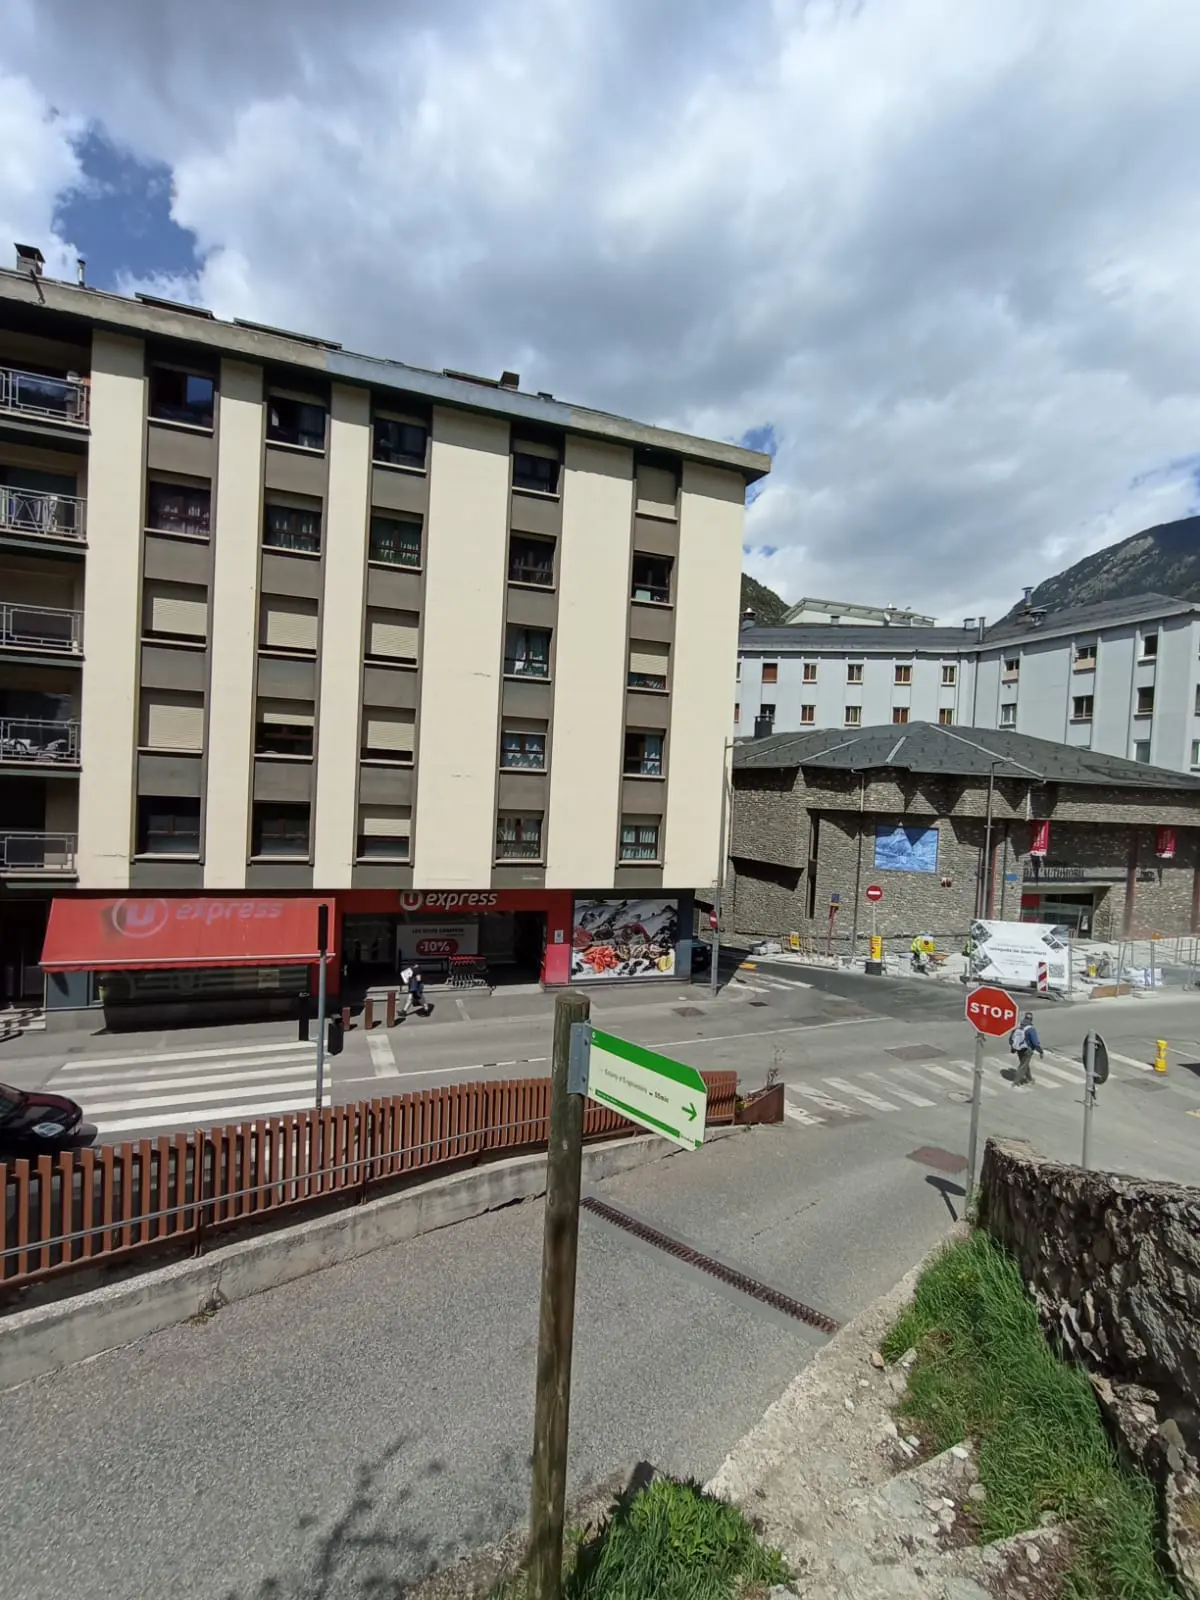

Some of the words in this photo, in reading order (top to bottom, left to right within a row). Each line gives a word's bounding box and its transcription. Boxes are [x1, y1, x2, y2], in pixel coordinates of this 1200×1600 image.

[425, 892, 498, 910] express
[175, 902, 284, 925] express
[420, 941, 450, 952] -10%
[970, 1002, 1014, 1020] STOP
